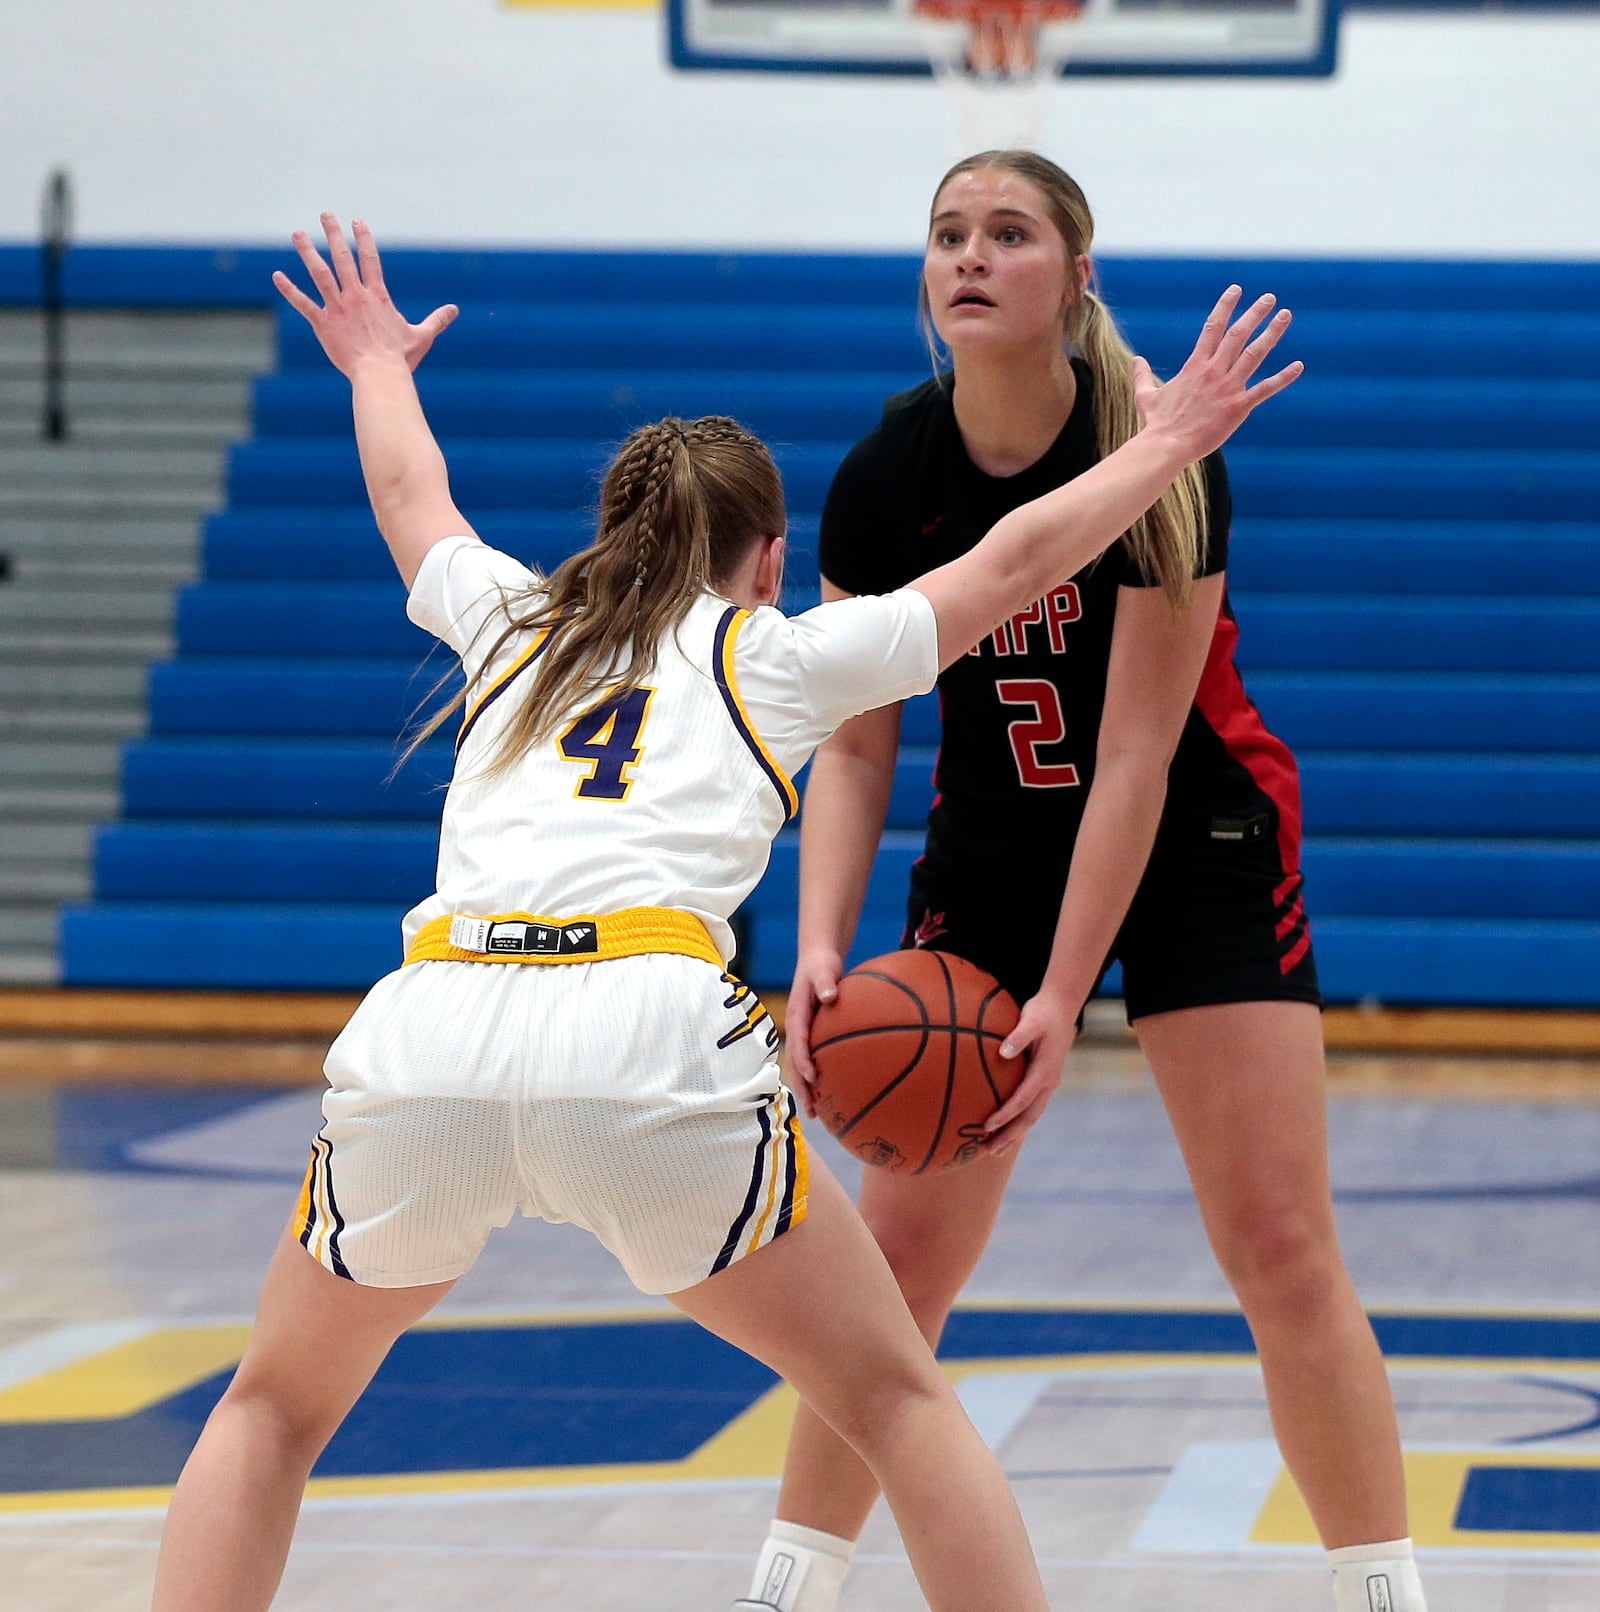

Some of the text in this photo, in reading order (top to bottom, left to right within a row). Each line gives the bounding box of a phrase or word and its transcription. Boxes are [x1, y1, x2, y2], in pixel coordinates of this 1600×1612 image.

[967, 581, 1082, 657] PP
[553, 683, 659, 803] 4
[995, 678, 1081, 789] 2
[1253, 824, 1260, 836] L
[537, 929, 548, 941] M
